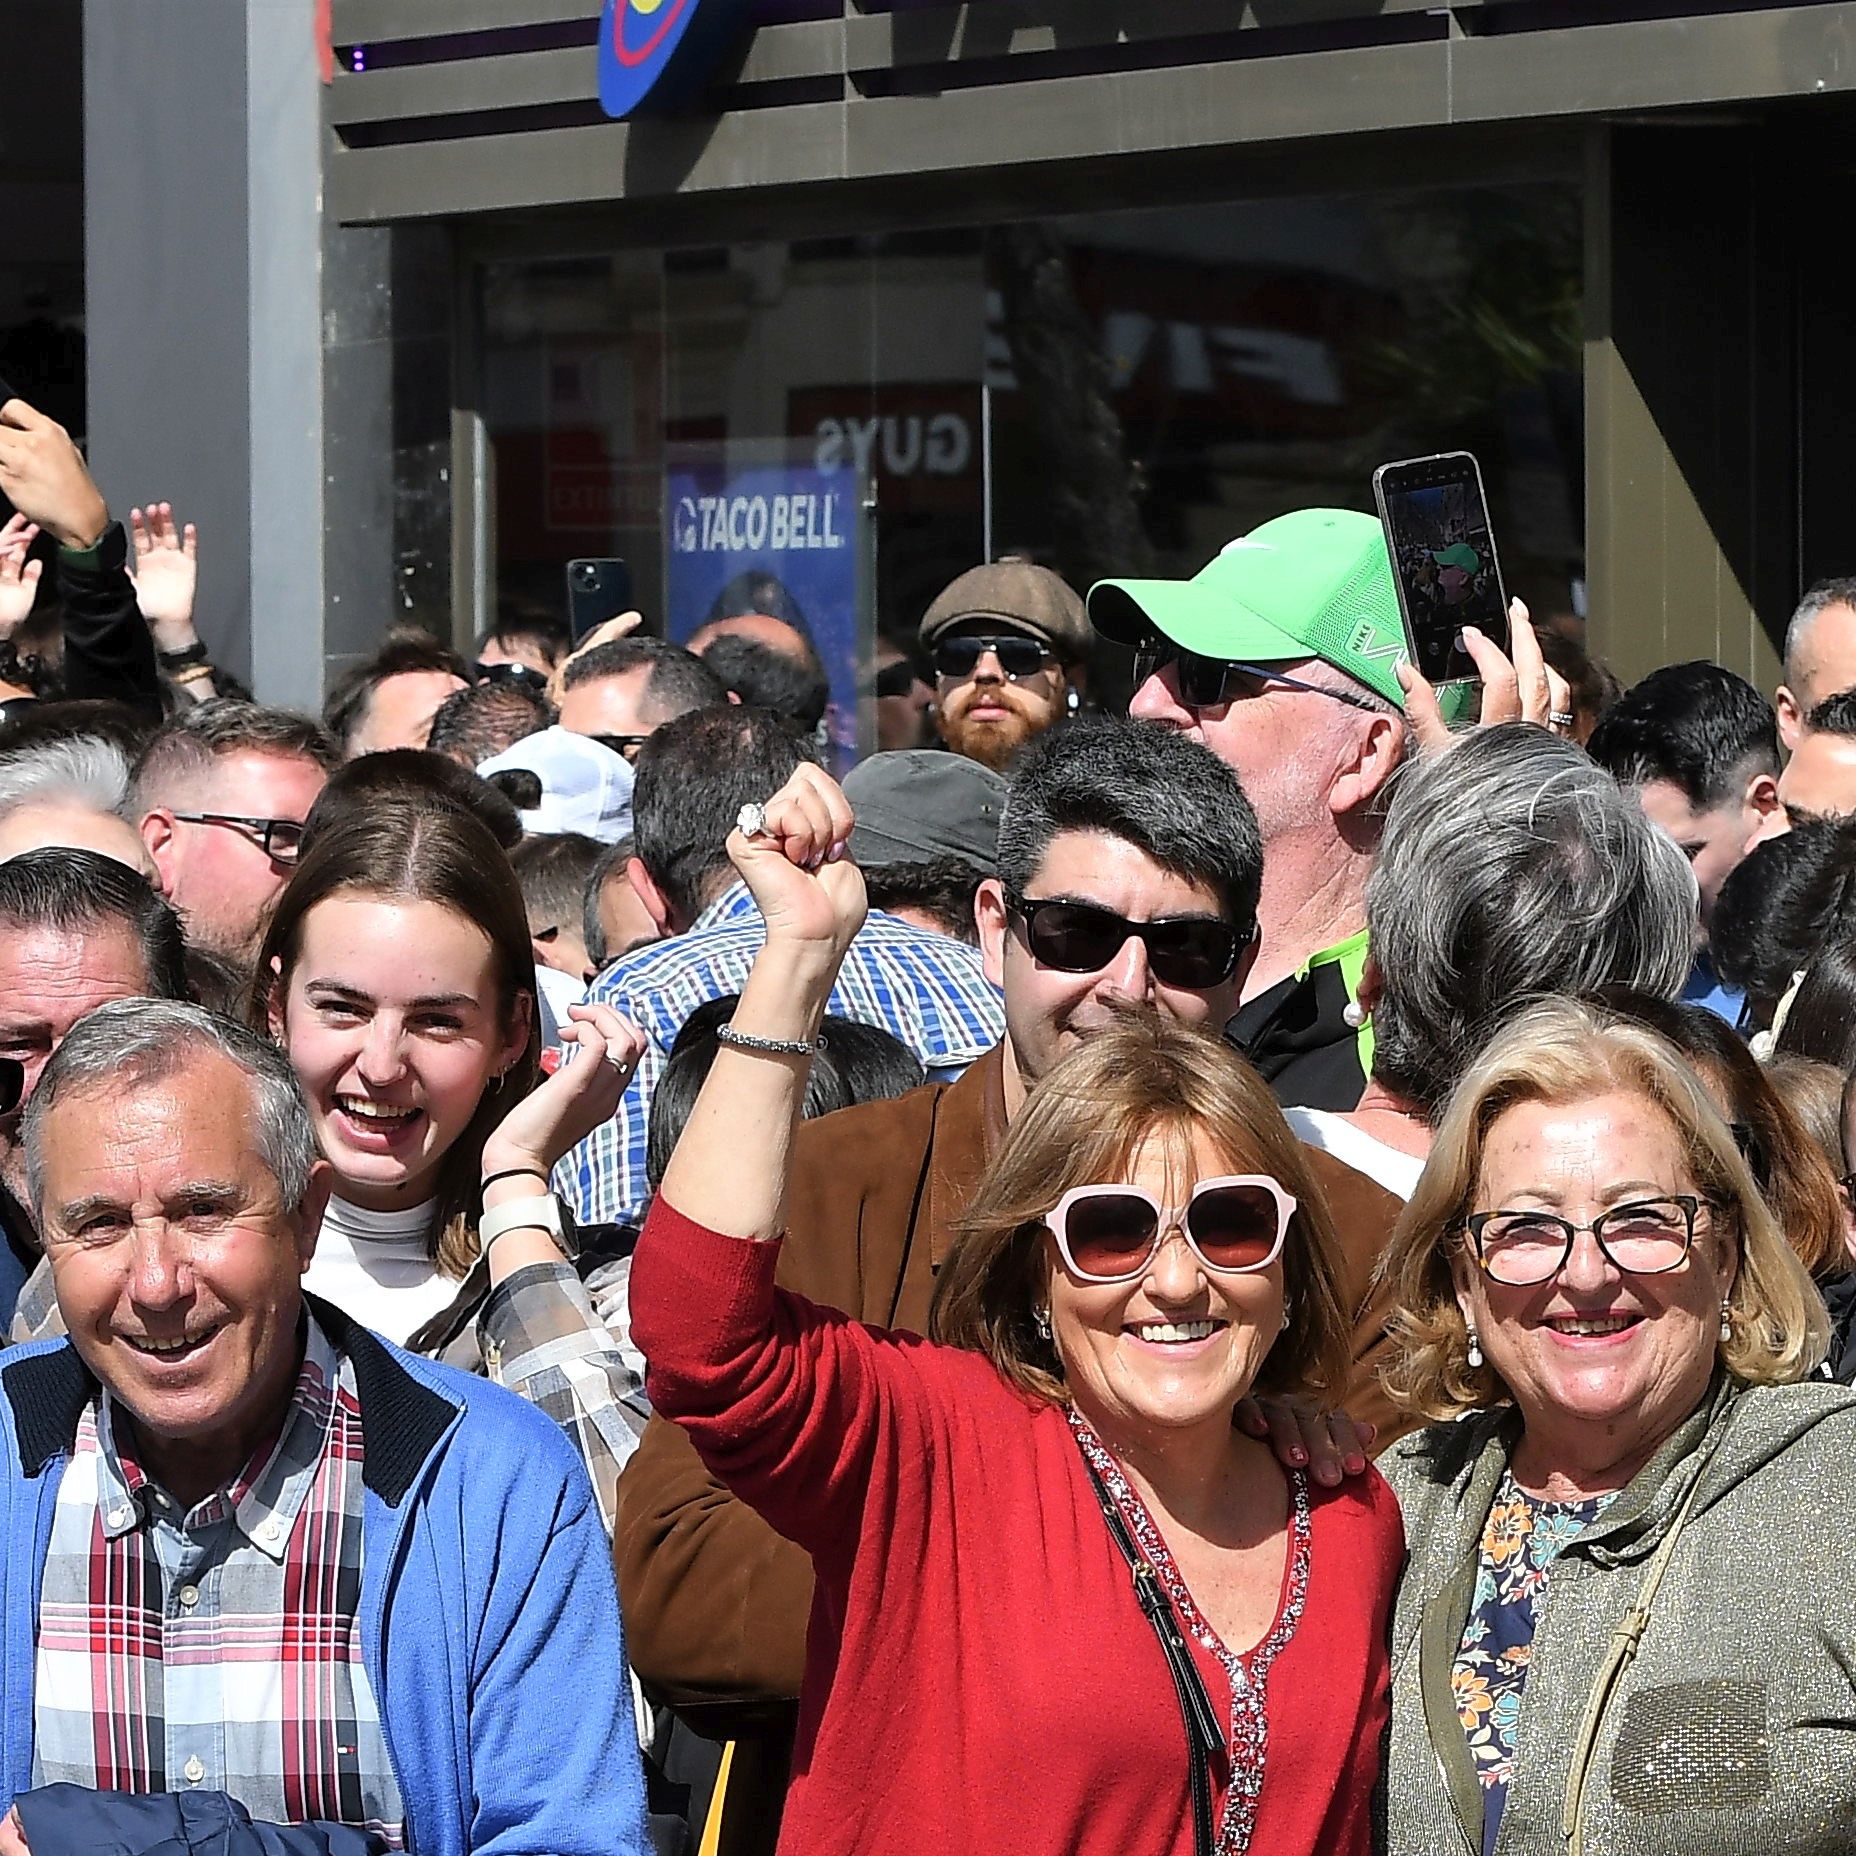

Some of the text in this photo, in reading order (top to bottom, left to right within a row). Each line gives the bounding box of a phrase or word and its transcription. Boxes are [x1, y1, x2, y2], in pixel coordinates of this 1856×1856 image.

[697, 494, 841, 551] TACO BELL
[1351, 624, 1372, 653] NIKE
